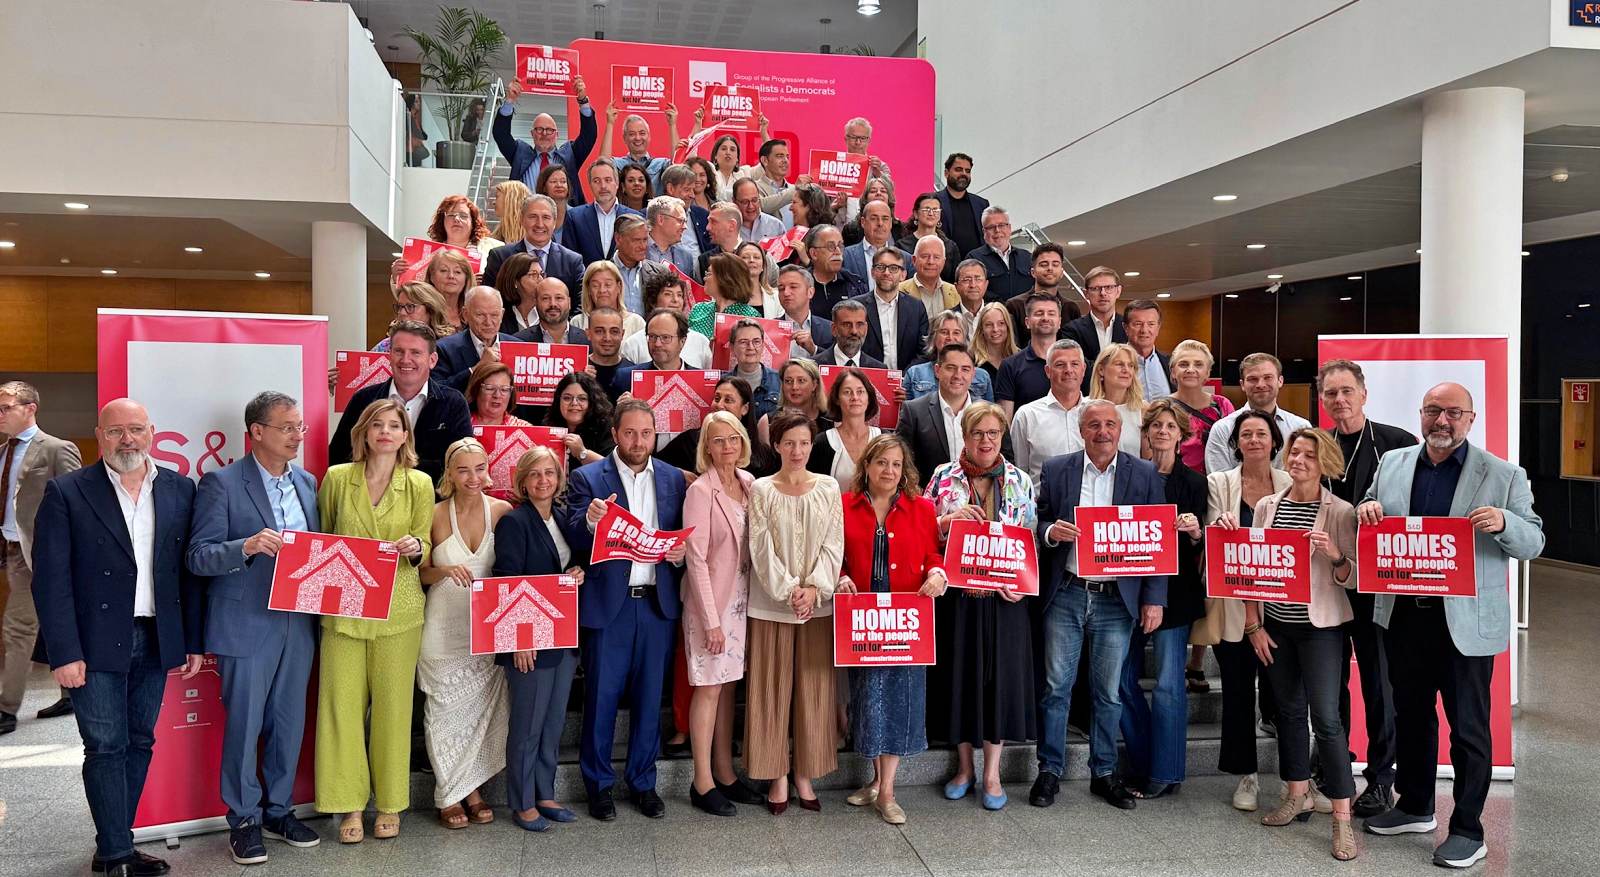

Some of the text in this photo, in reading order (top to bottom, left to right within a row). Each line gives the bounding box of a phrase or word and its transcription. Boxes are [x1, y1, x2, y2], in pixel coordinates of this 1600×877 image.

[527, 57, 570, 74] HOMES
[623, 75, 665, 92] HOMES
[734, 74, 752, 82] Group
[771, 76, 805, 84] Progressive
[786, 85, 835, 95] Democrats
[712, 95, 753, 110] HOMES
[820, 160, 861, 177] HOMES
[515, 356, 574, 376] HOMES
[514, 375, 525, 383] for
[528, 375, 541, 384] the
[611, 516, 678, 549] HOMES
[1094, 520, 1162, 542] HOMES
[963, 534, 1026, 560] HOMES
[1094, 542, 1163, 553] for the people,
[1377, 533, 1457, 558] HOMES
[961, 554, 975, 565] for
[976, 555, 992, 567] the
[1094, 554, 1109, 563] not
[1224, 543, 1296, 567] HOMES
[1377, 556, 1458, 571] for the people,
[1224, 564, 1296, 579] for the people,
[1378, 569, 1393, 579] not
[1397, 569, 1411, 579] for
[1225, 576, 1240, 586] not
[1241, 577, 1255, 586] for
[852, 608, 919, 630] HOMES
[852, 631, 865, 641] for
[868, 631, 883, 641] the
[853, 643, 866, 652] not
[869, 642, 880, 652] for
